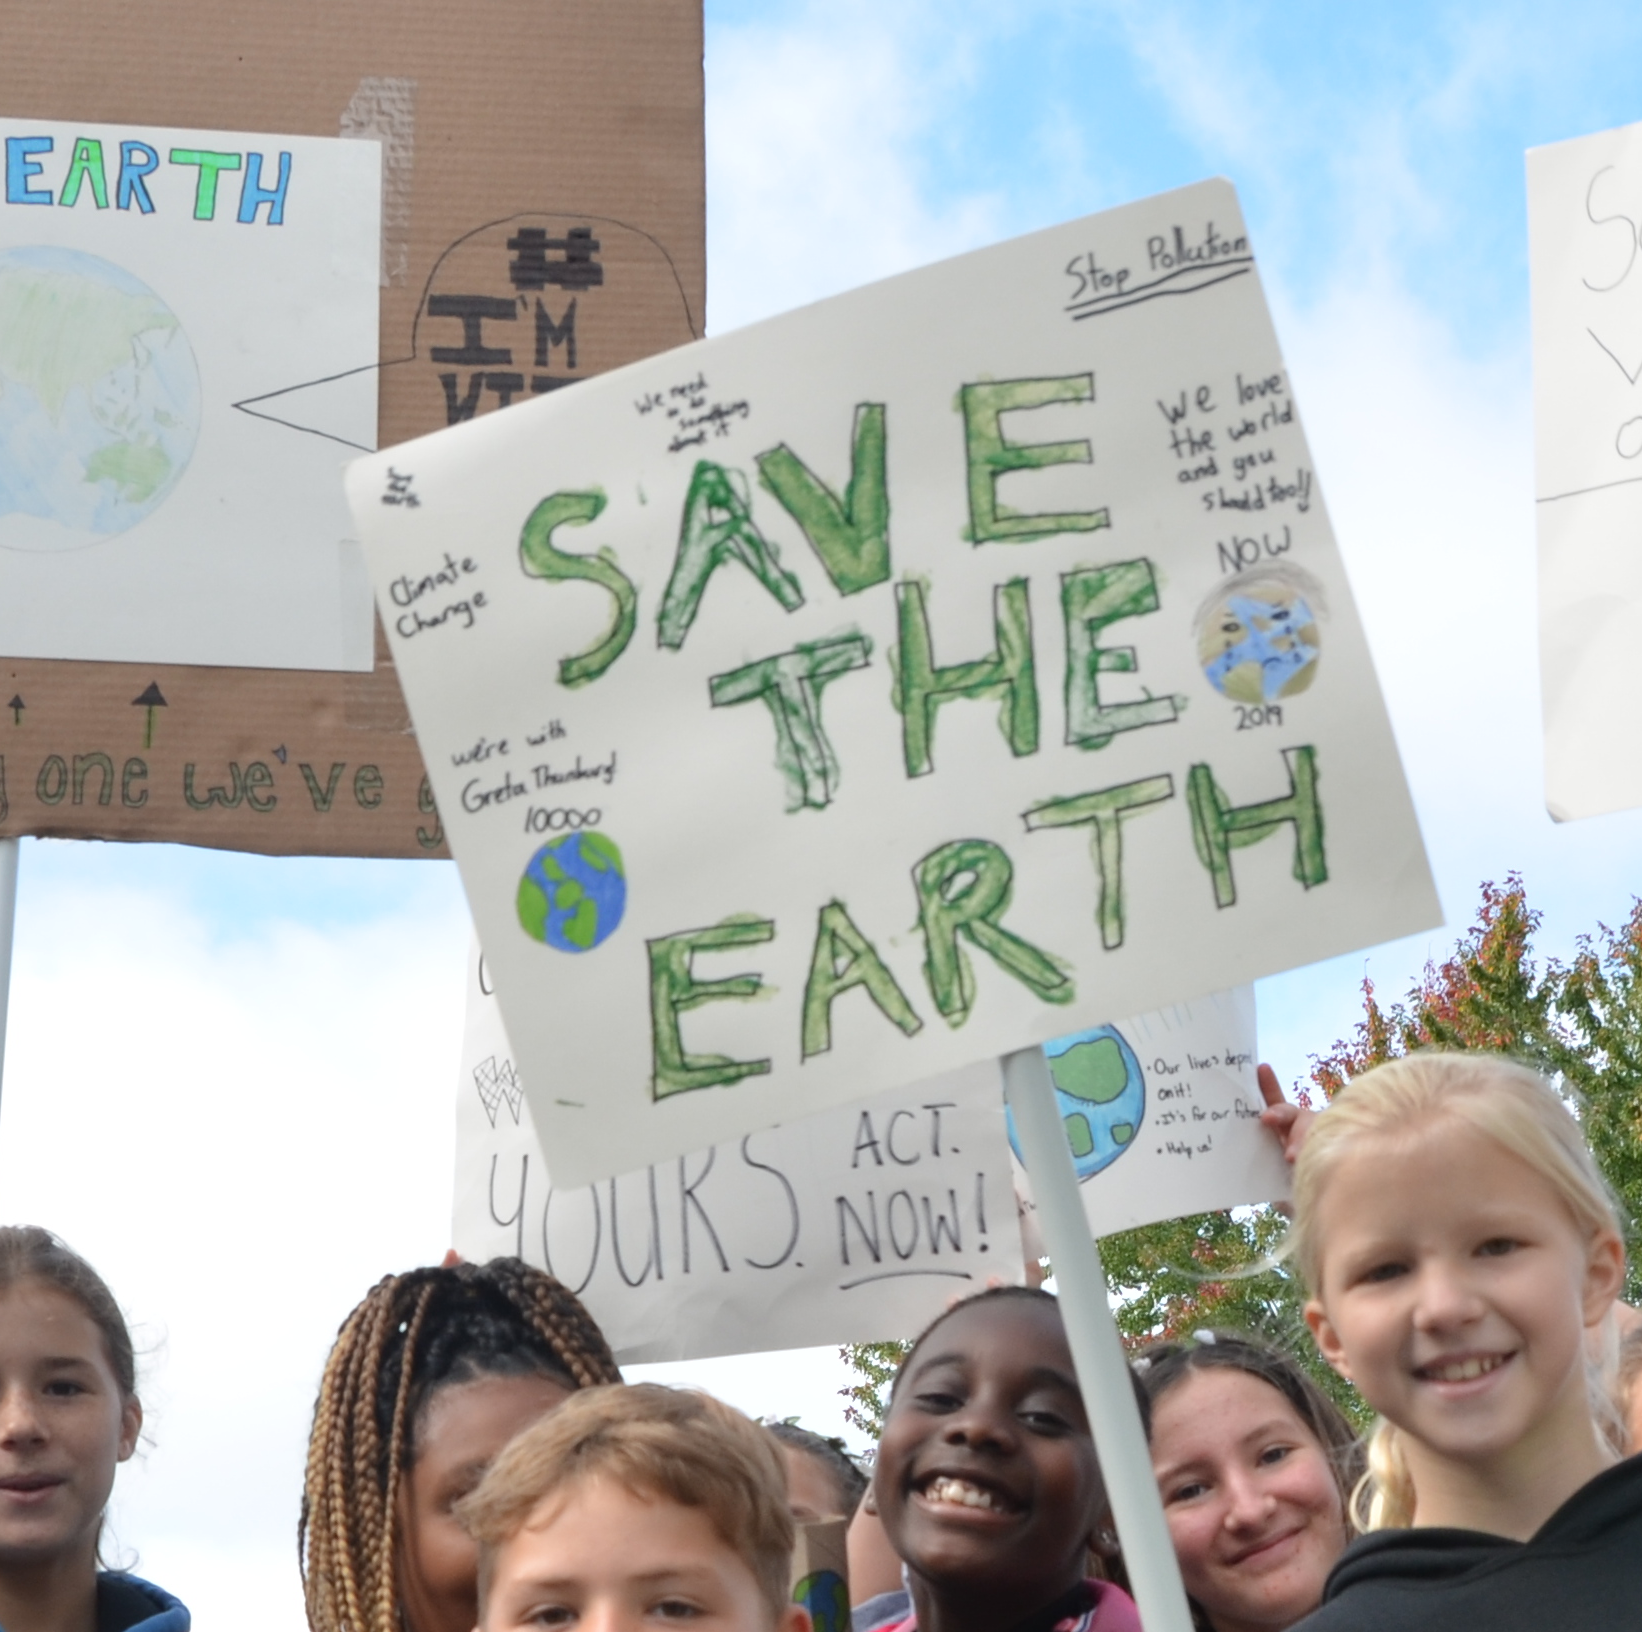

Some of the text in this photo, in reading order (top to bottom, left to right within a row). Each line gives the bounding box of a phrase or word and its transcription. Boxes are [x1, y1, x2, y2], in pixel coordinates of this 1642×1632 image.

[5, 135, 292, 226] EARTH
[1063, 220, 1248, 301] Stop Pollution
[427, 293, 578, 369] I'M
[1235, 371, 1284, 407] love
[1168, 398, 1295, 460] the world
[1176, 447, 1277, 484] and you
[518, 370, 1112, 690] SAVE
[1216, 524, 1292, 573] NOW
[389, 552, 479, 608] Climate
[395, 590, 489, 640] Change
[707, 555, 1189, 816] THE
[525, 718, 567, 746] with
[1233, 702, 1284, 731] 2019
[35, 752, 149, 809] one
[182, 742, 385, 813] we've
[461, 772, 528, 814] Greta
[523, 806, 603, 834] 10000
[645, 743, 1330, 1103] EARTH
[1153, 1057, 1182, 1075] Our
[1211, 1109, 1230, 1122] our
[1164, 1140, 1193, 1160] Help
[833, 1172, 990, 1265] NOW!
